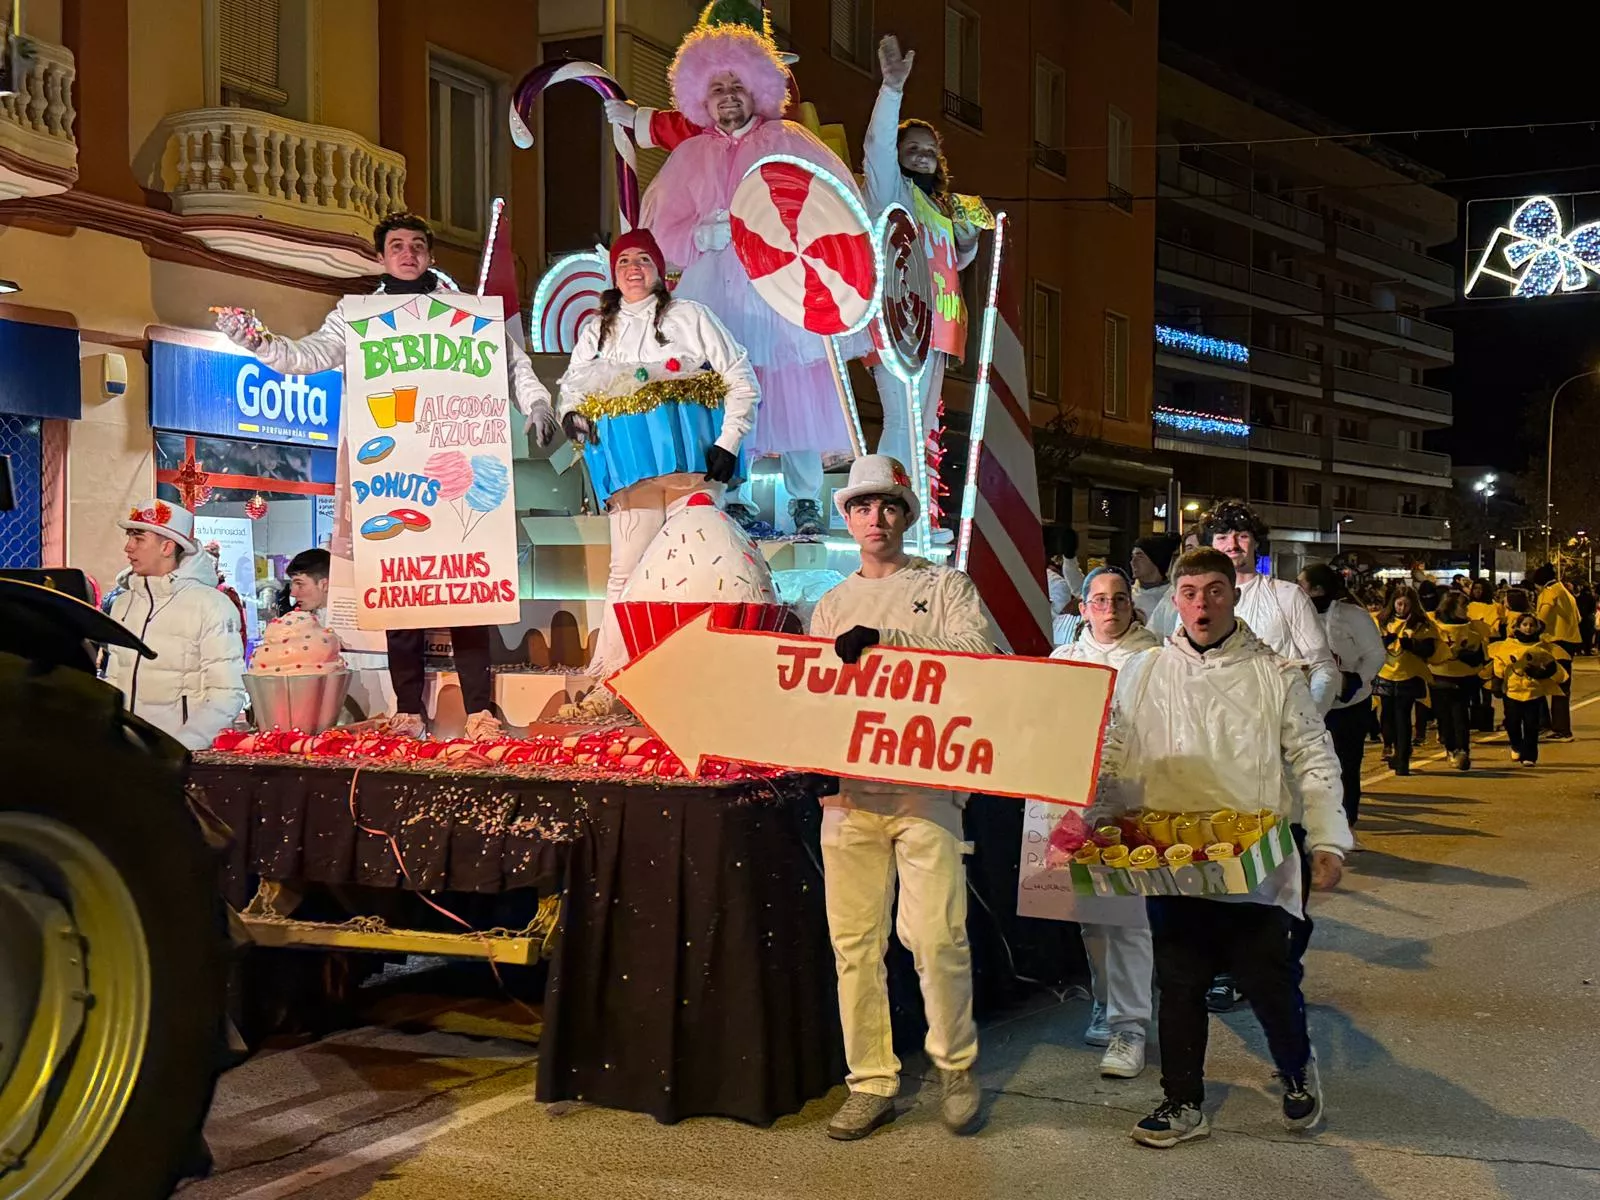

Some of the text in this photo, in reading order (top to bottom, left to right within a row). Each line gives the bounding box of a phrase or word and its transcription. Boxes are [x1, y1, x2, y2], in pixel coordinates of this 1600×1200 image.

[360, 333, 498, 380] BEBIDAS
[236, 363, 328, 427] Gotta
[420, 394, 507, 422] ALGODÓN
[261, 425, 306, 438] PERFUMERÍAS
[415, 419, 507, 448] DE AZÚCAR
[352, 472, 441, 507] DONUTS
[380, 552, 490, 583] MANZANAS
[364, 579, 515, 609] CARAMELIZADAS
[1088, 861, 1228, 897] JUNIOR
